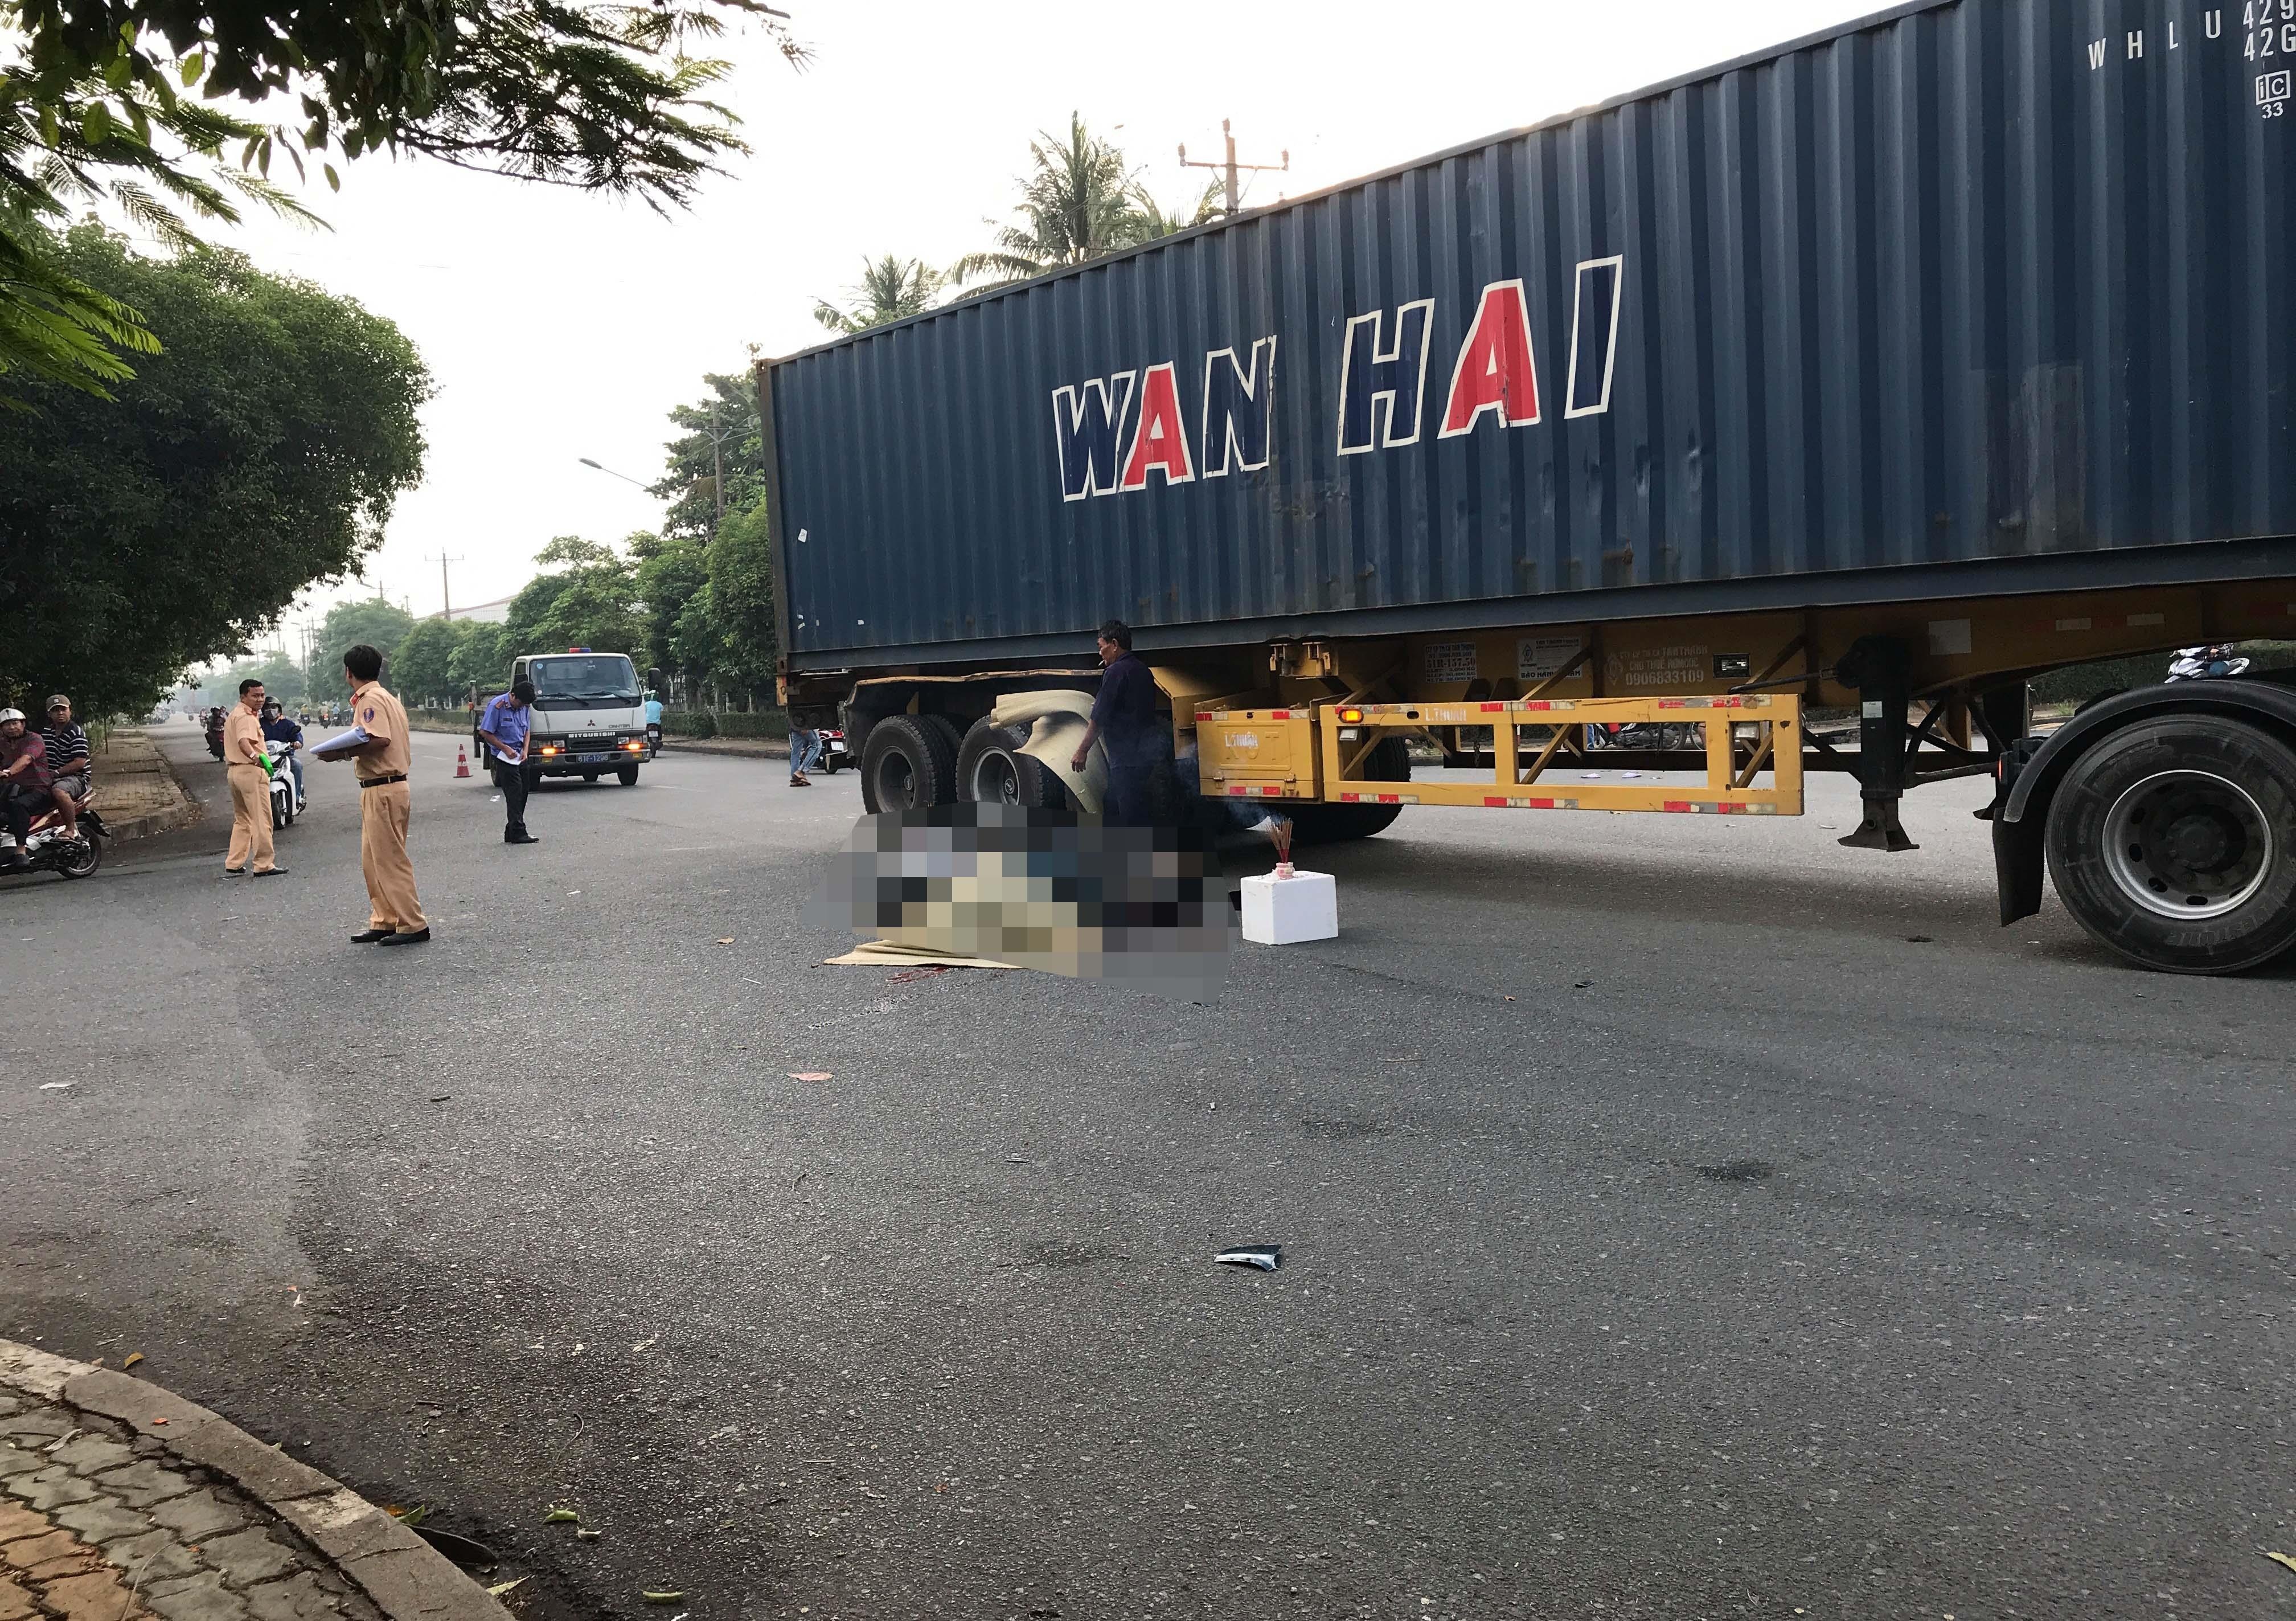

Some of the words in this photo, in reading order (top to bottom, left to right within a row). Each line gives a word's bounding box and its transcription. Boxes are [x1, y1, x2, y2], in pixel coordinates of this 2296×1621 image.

[2262, 101, 2283, 119] 33
[1052, 334, 1277, 502] WAN
[1338, 254, 1622, 456] HAI
[1625, 669, 1704, 686] 0906833109
